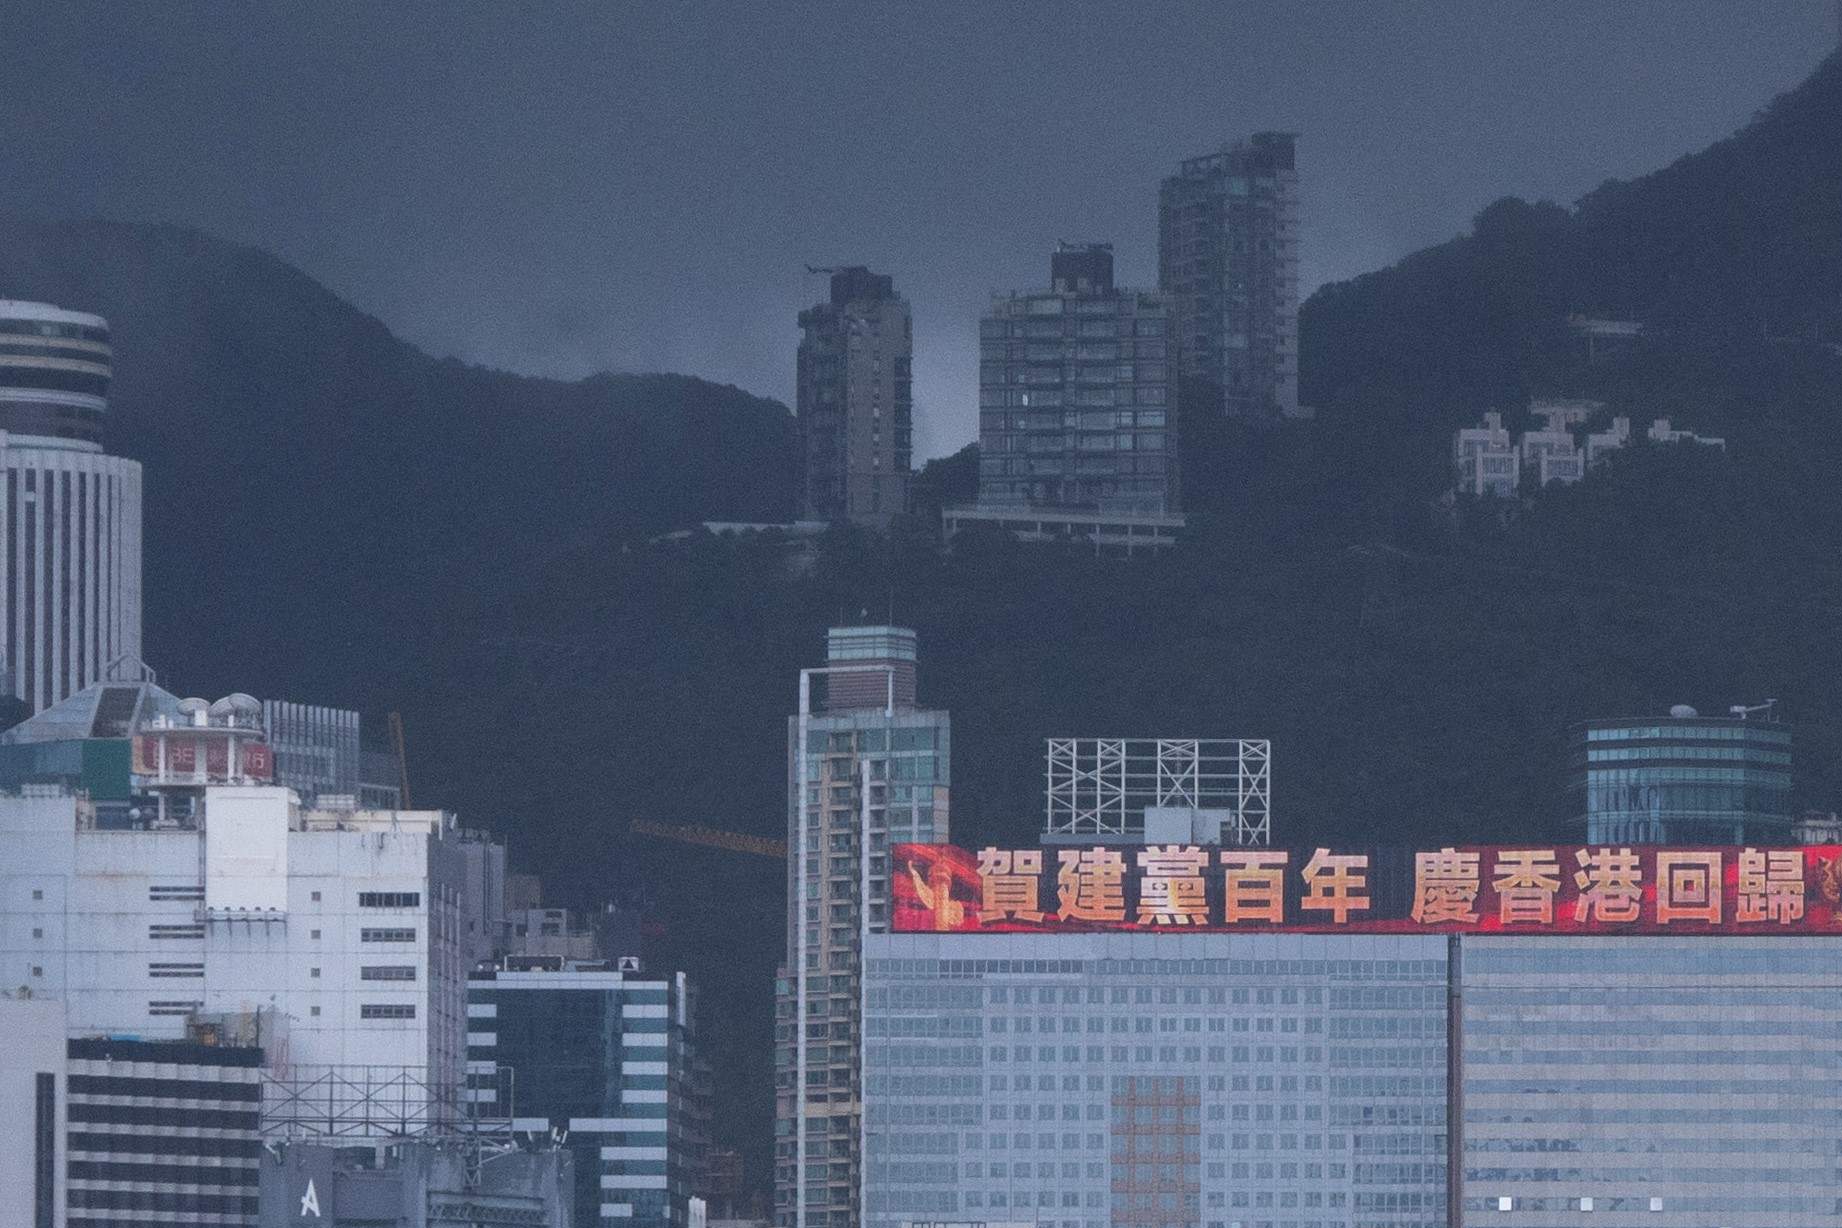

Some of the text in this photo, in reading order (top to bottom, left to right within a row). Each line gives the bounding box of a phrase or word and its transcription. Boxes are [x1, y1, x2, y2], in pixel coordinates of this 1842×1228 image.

[976, 845, 1805, 924] 賀建黨百年 慶香港回歸
